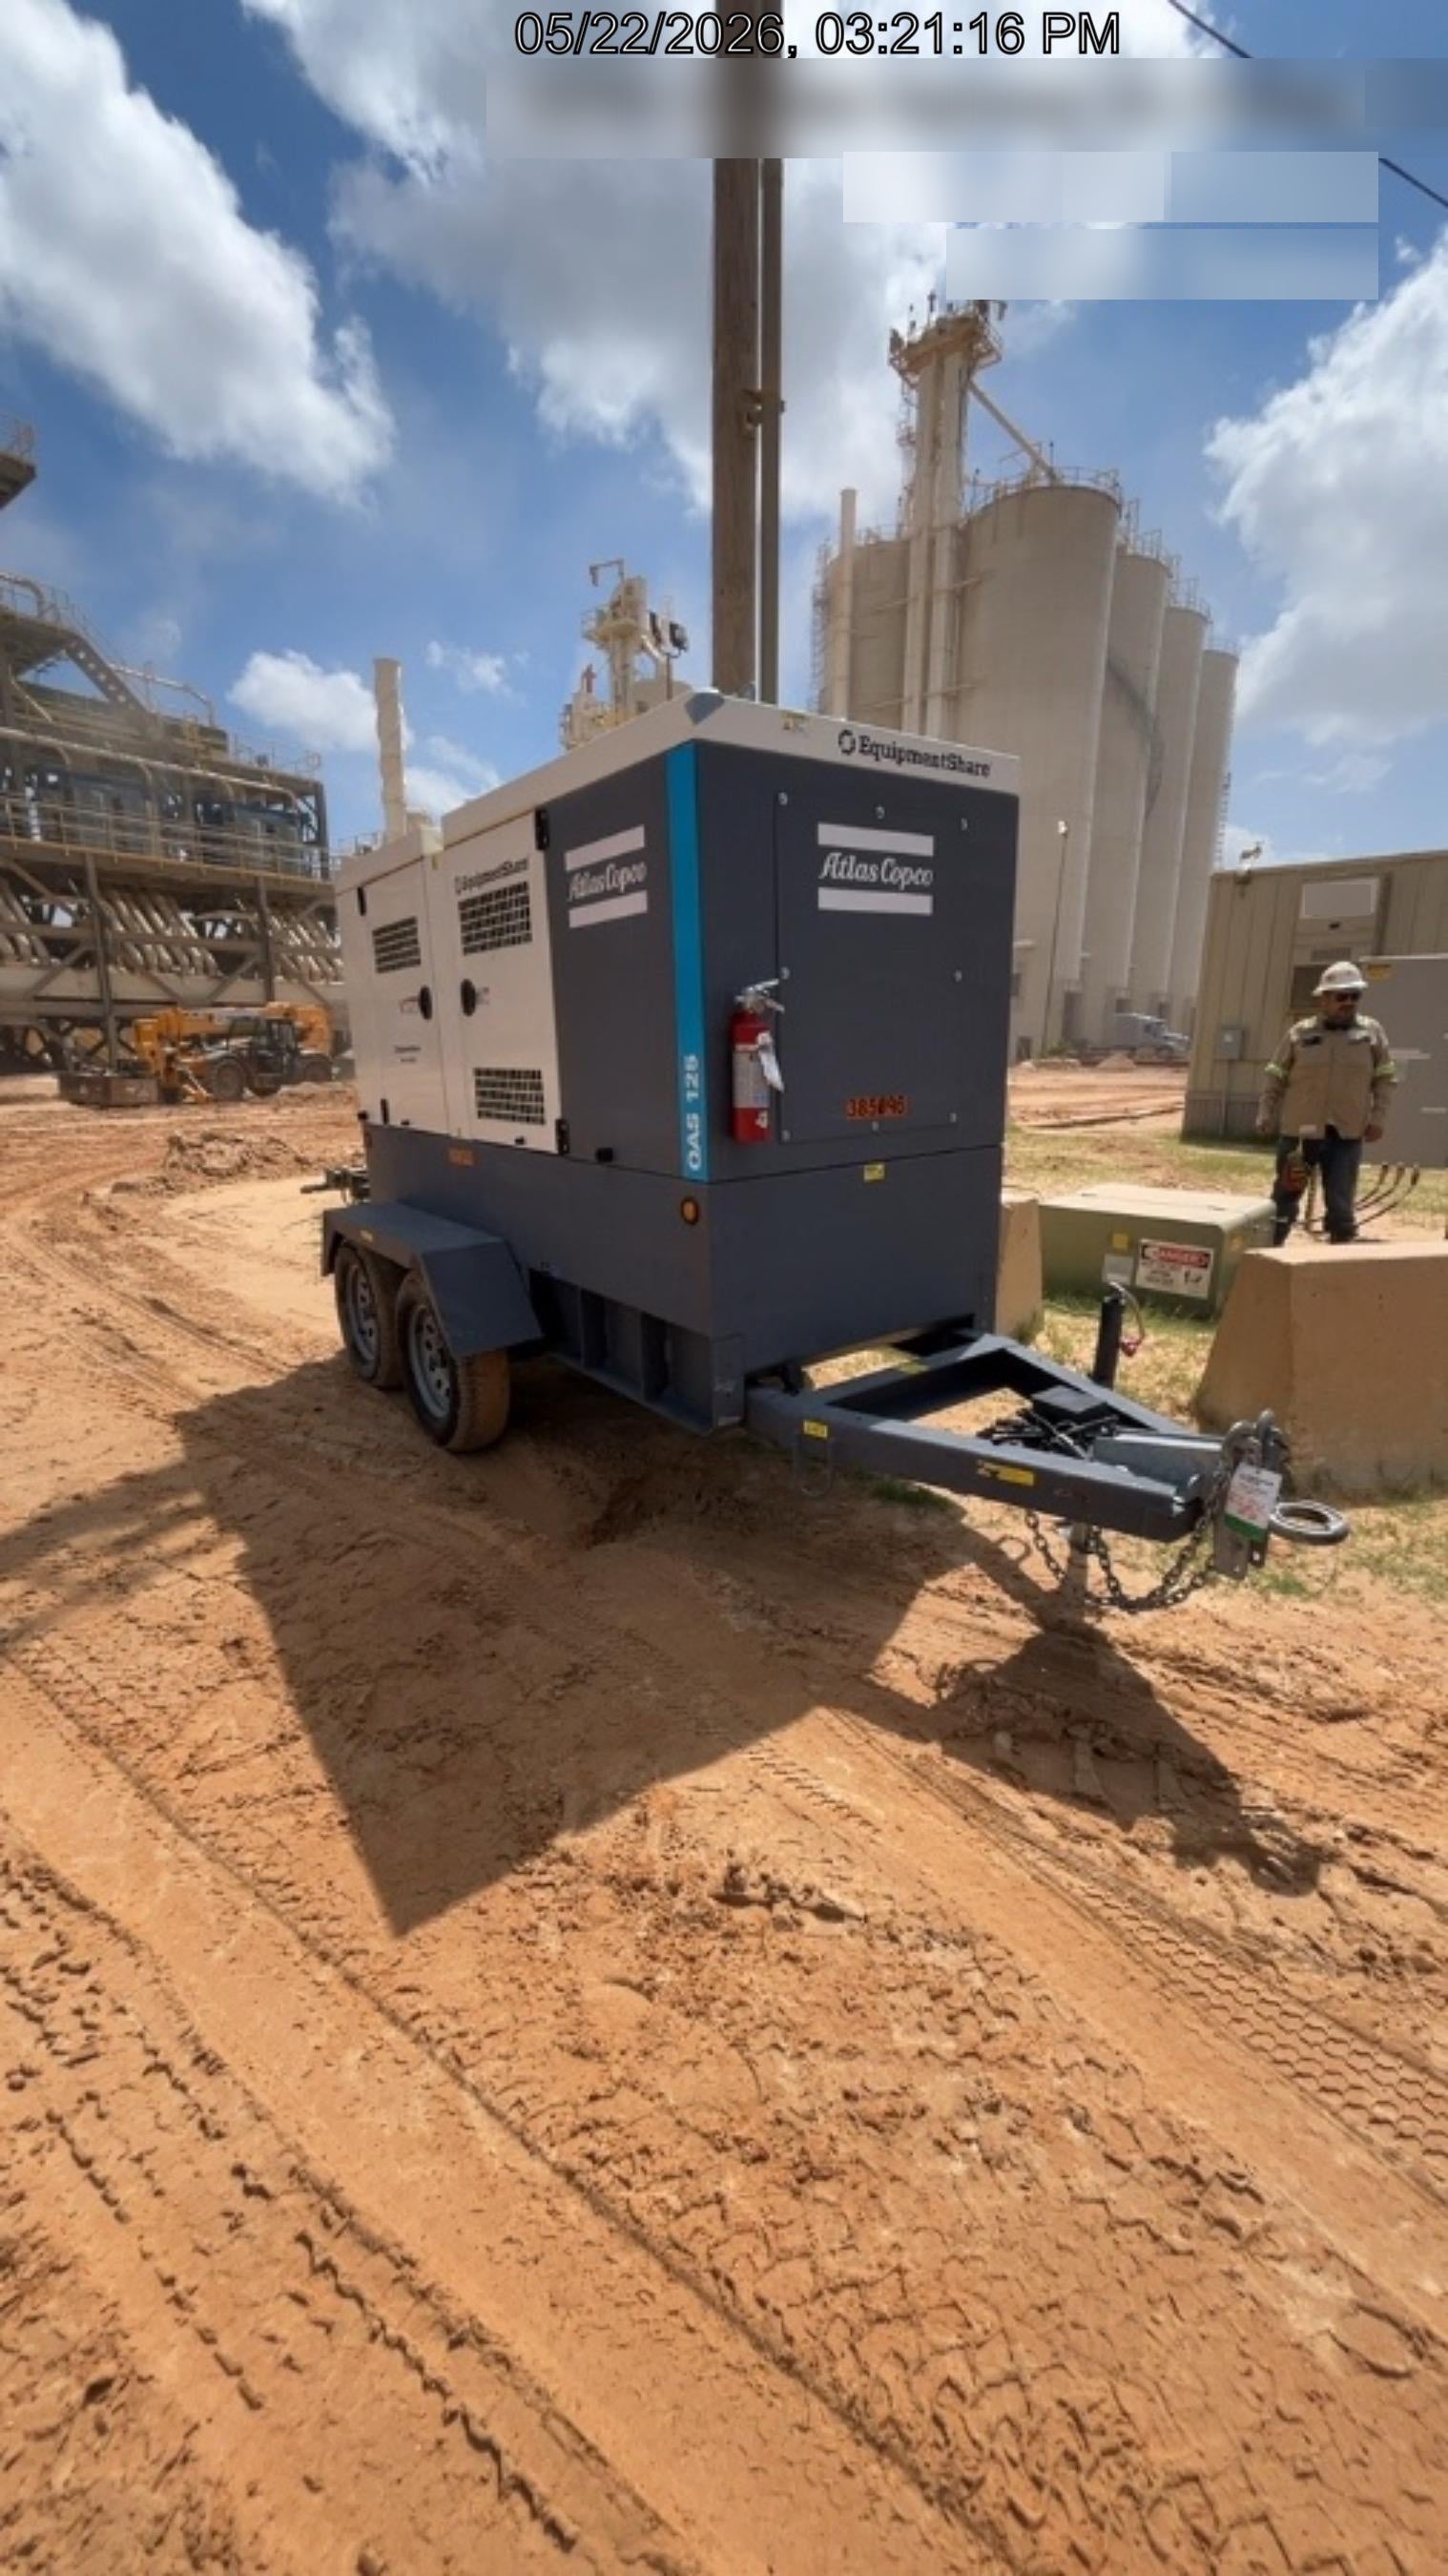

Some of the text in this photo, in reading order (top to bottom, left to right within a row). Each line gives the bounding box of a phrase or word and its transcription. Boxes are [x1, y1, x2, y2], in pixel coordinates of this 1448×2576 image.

[858, 734, 992, 778] EquipmentShare
[568, 861, 648, 902] Atlas Copco
[818, 851, 934, 890] Atlas Copco
